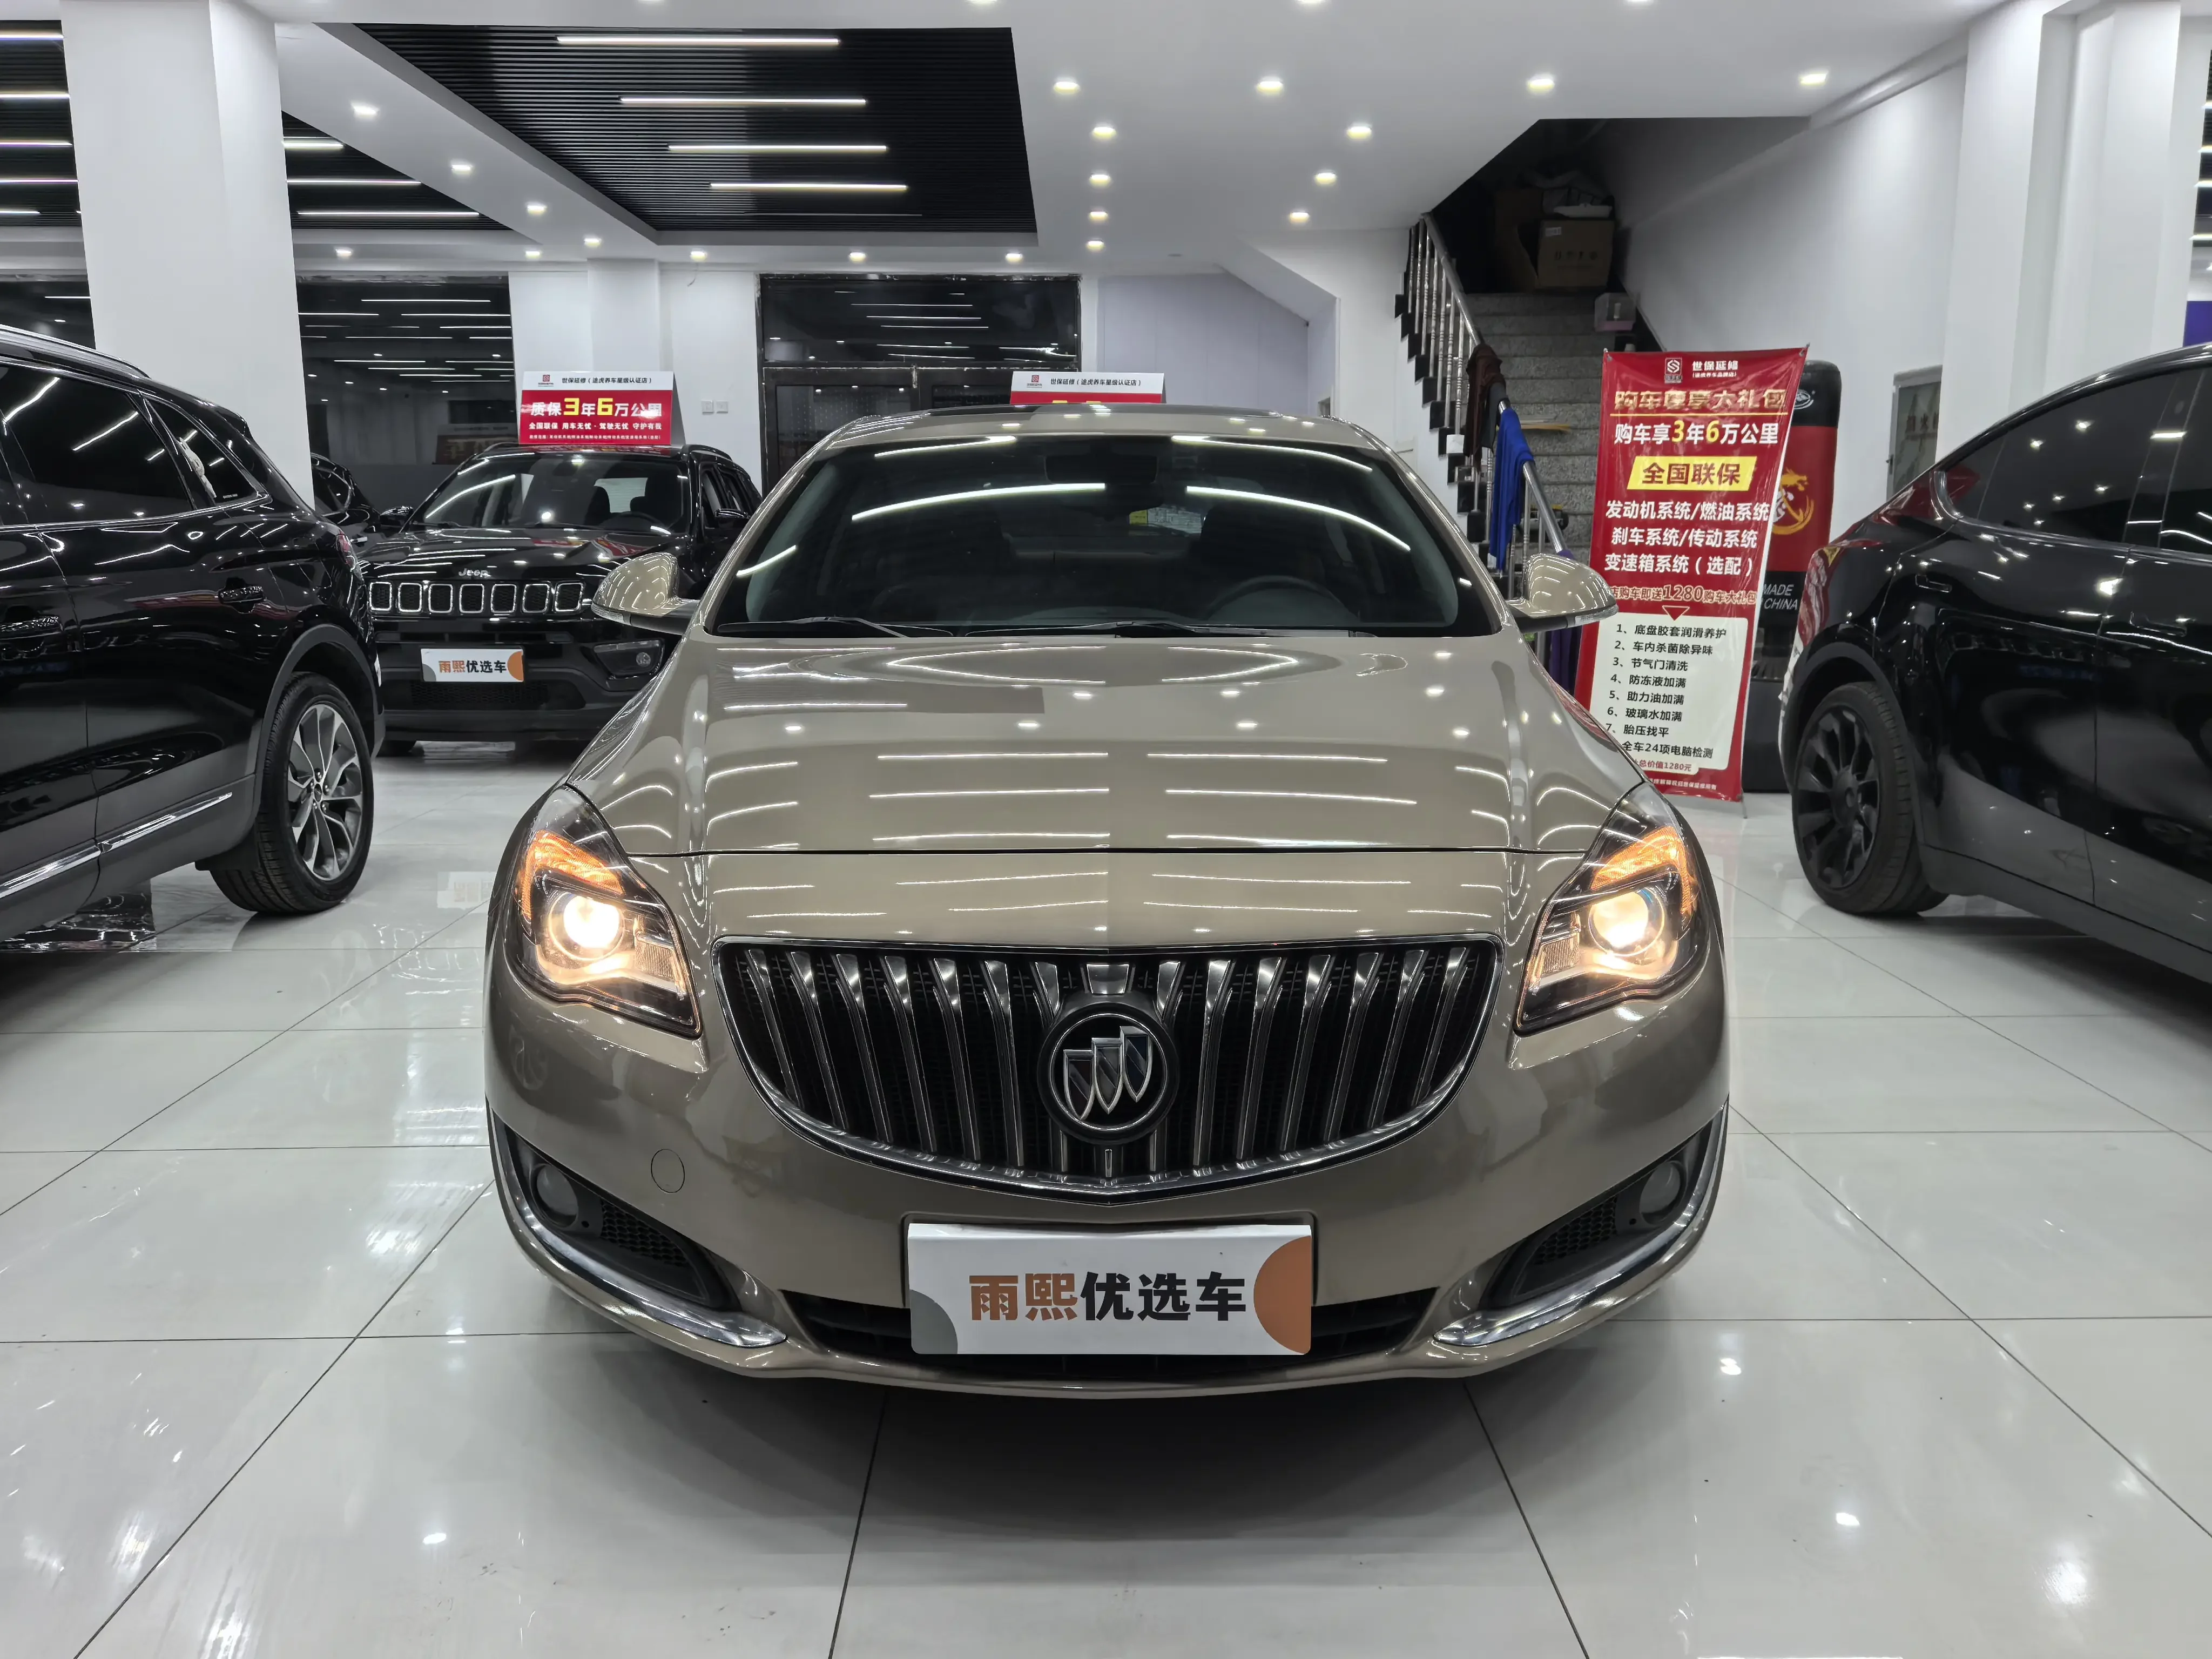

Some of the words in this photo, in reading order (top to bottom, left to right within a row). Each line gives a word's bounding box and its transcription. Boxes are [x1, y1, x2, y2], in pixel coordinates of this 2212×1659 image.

[1614, 388, 1786, 411] 购车尊享大礼包
[1614, 420, 1779, 445] 购车享3年6万公里
[1641, 462, 1741, 487] 全国联保
[1605, 500, 1769, 522] 发动机系统/燃油系统
[1611, 526, 1758, 549] 刹车系统/传动系统
[1763, 584, 1794, 596] MADE
[1764, 598, 1798, 610] CHINA
[438, 659, 507, 674] 雨熙优选车
[1622, 740, 1714, 759] 全车24项电脑检测
[969, 1270, 1247, 1321] 雨熙优选车
